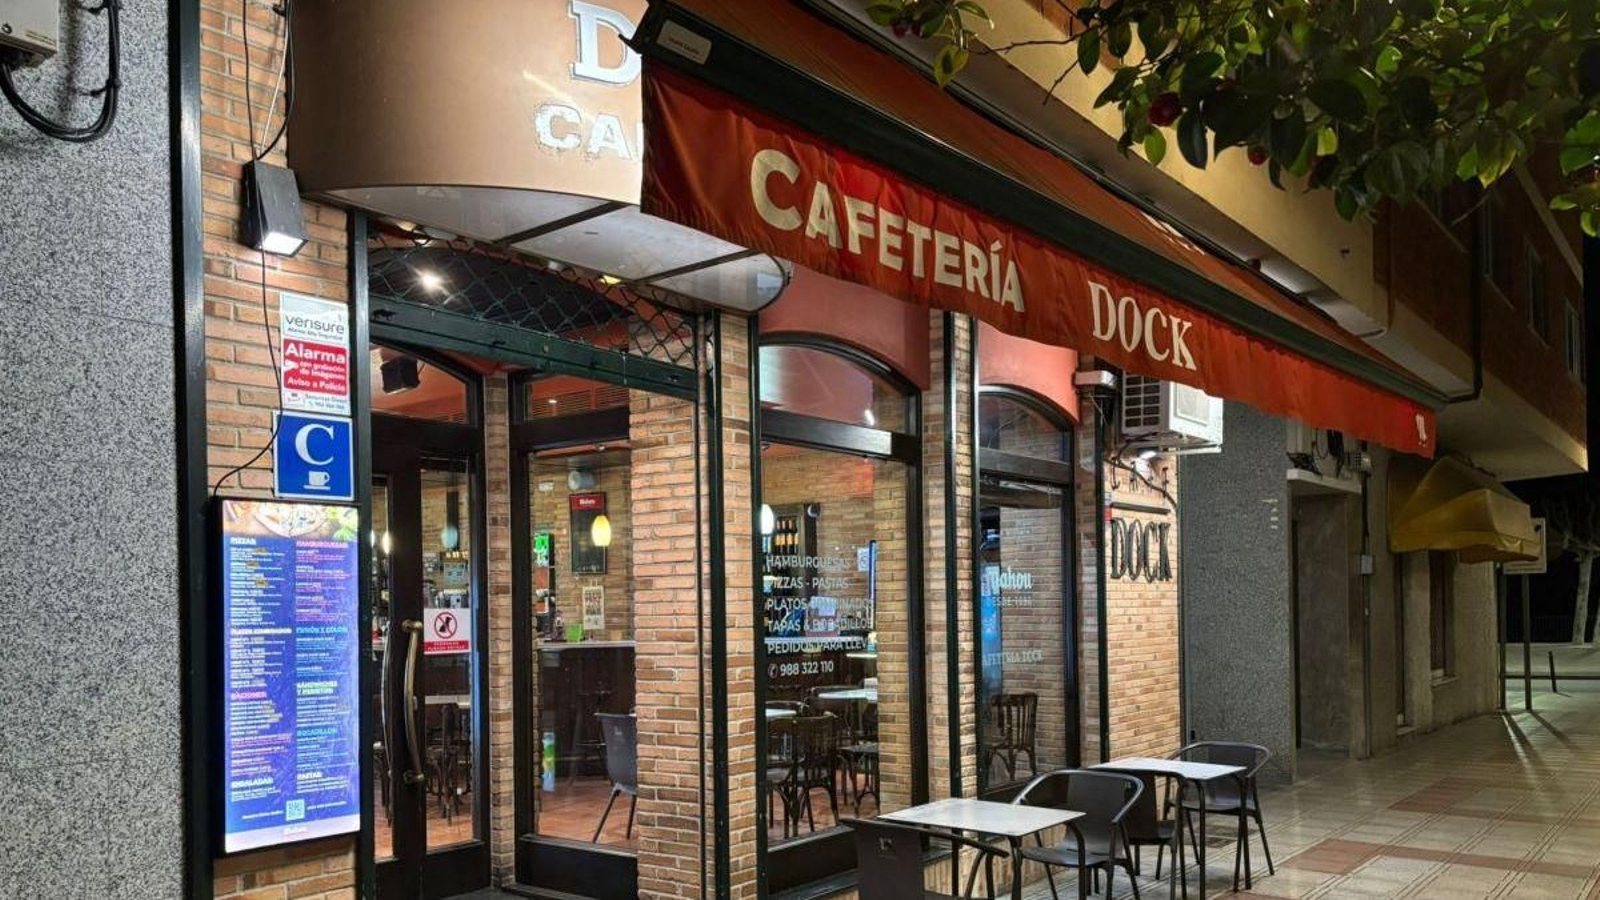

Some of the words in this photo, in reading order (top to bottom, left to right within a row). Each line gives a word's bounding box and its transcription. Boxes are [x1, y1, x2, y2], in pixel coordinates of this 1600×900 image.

[750, 149, 1025, 314] CAFETERÍA
[1087, 280, 1197, 371] DOCK
[285, 315, 345, 334] verisure
[285, 343, 346, 363] Alarma
[287, 376, 311, 387] Aviso
[295, 423, 335, 465] C
[1110, 516, 1173, 582] DOCK
[765, 554, 851, 569] HAMBURGUESAS
[812, 577, 849, 589] PASTAS
[767, 597, 807, 610] PLATOS
[768, 620, 804, 633] TAPAS
[780, 663, 800, 677] 988
[802, 661, 819, 674] 322
[820, 660, 834, 673] 110
